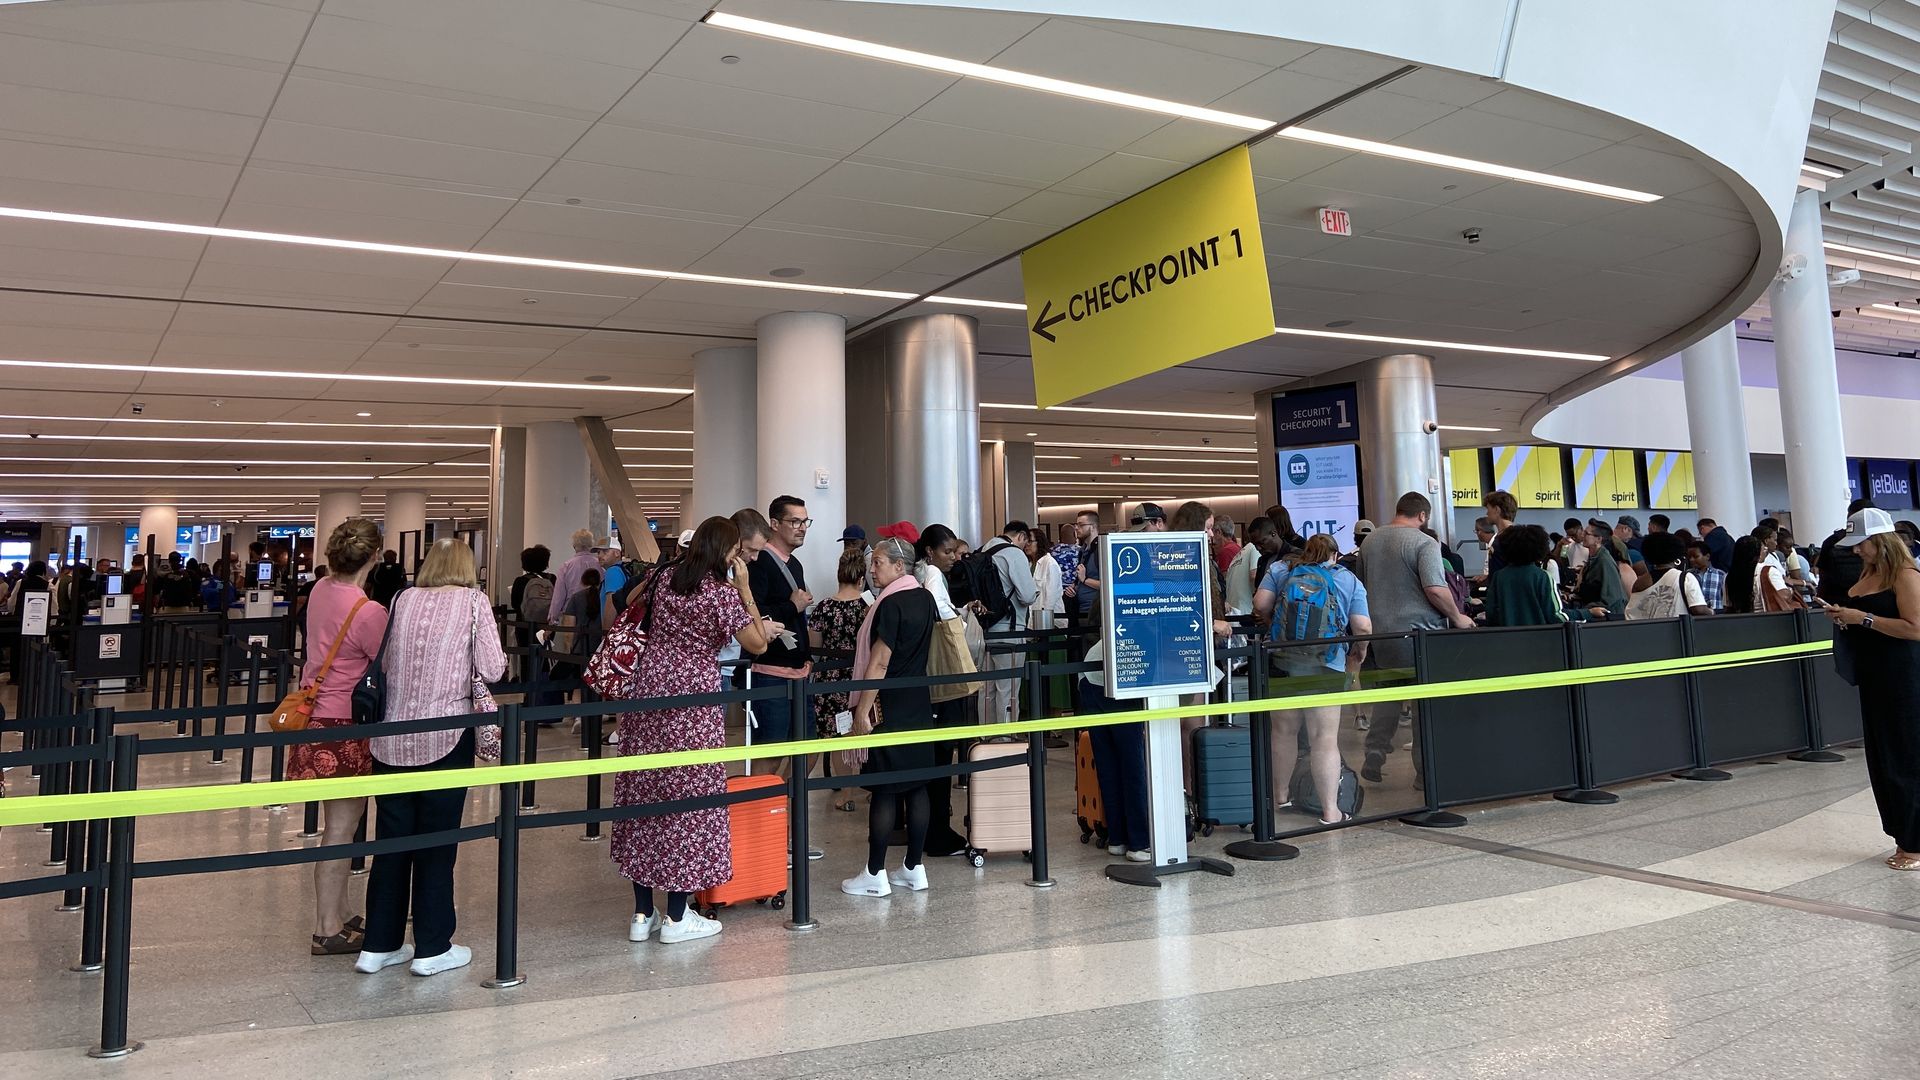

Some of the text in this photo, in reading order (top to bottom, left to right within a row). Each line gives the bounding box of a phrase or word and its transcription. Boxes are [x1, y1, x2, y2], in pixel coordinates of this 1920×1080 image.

[1325, 211, 1346, 233] EXIT
[1068, 228, 1243, 322] CHECKPOINT 1
[1293, 406, 1331, 419] SECURITY
[1336, 400, 1351, 428] 1
[1280, 417, 1332, 431] CHECKPOINT
[1871, 473, 1907, 498] jetBlue
[1452, 488, 1478, 501] spirit
[1535, 490, 1561, 502] spirit
[1611, 491, 1635, 503] spirit
[1158, 552, 1186, 561] For your
[1158, 562, 1198, 571] information
[1117, 597, 1137, 605] Please
[1148, 596, 1170, 604] Airlines
[1170, 595, 1179, 603] for
[1180, 595, 1197, 603] ticket
[1122, 604, 1194, 615] and baggage information.
[1127, 662, 1150, 670] COUNTRY
